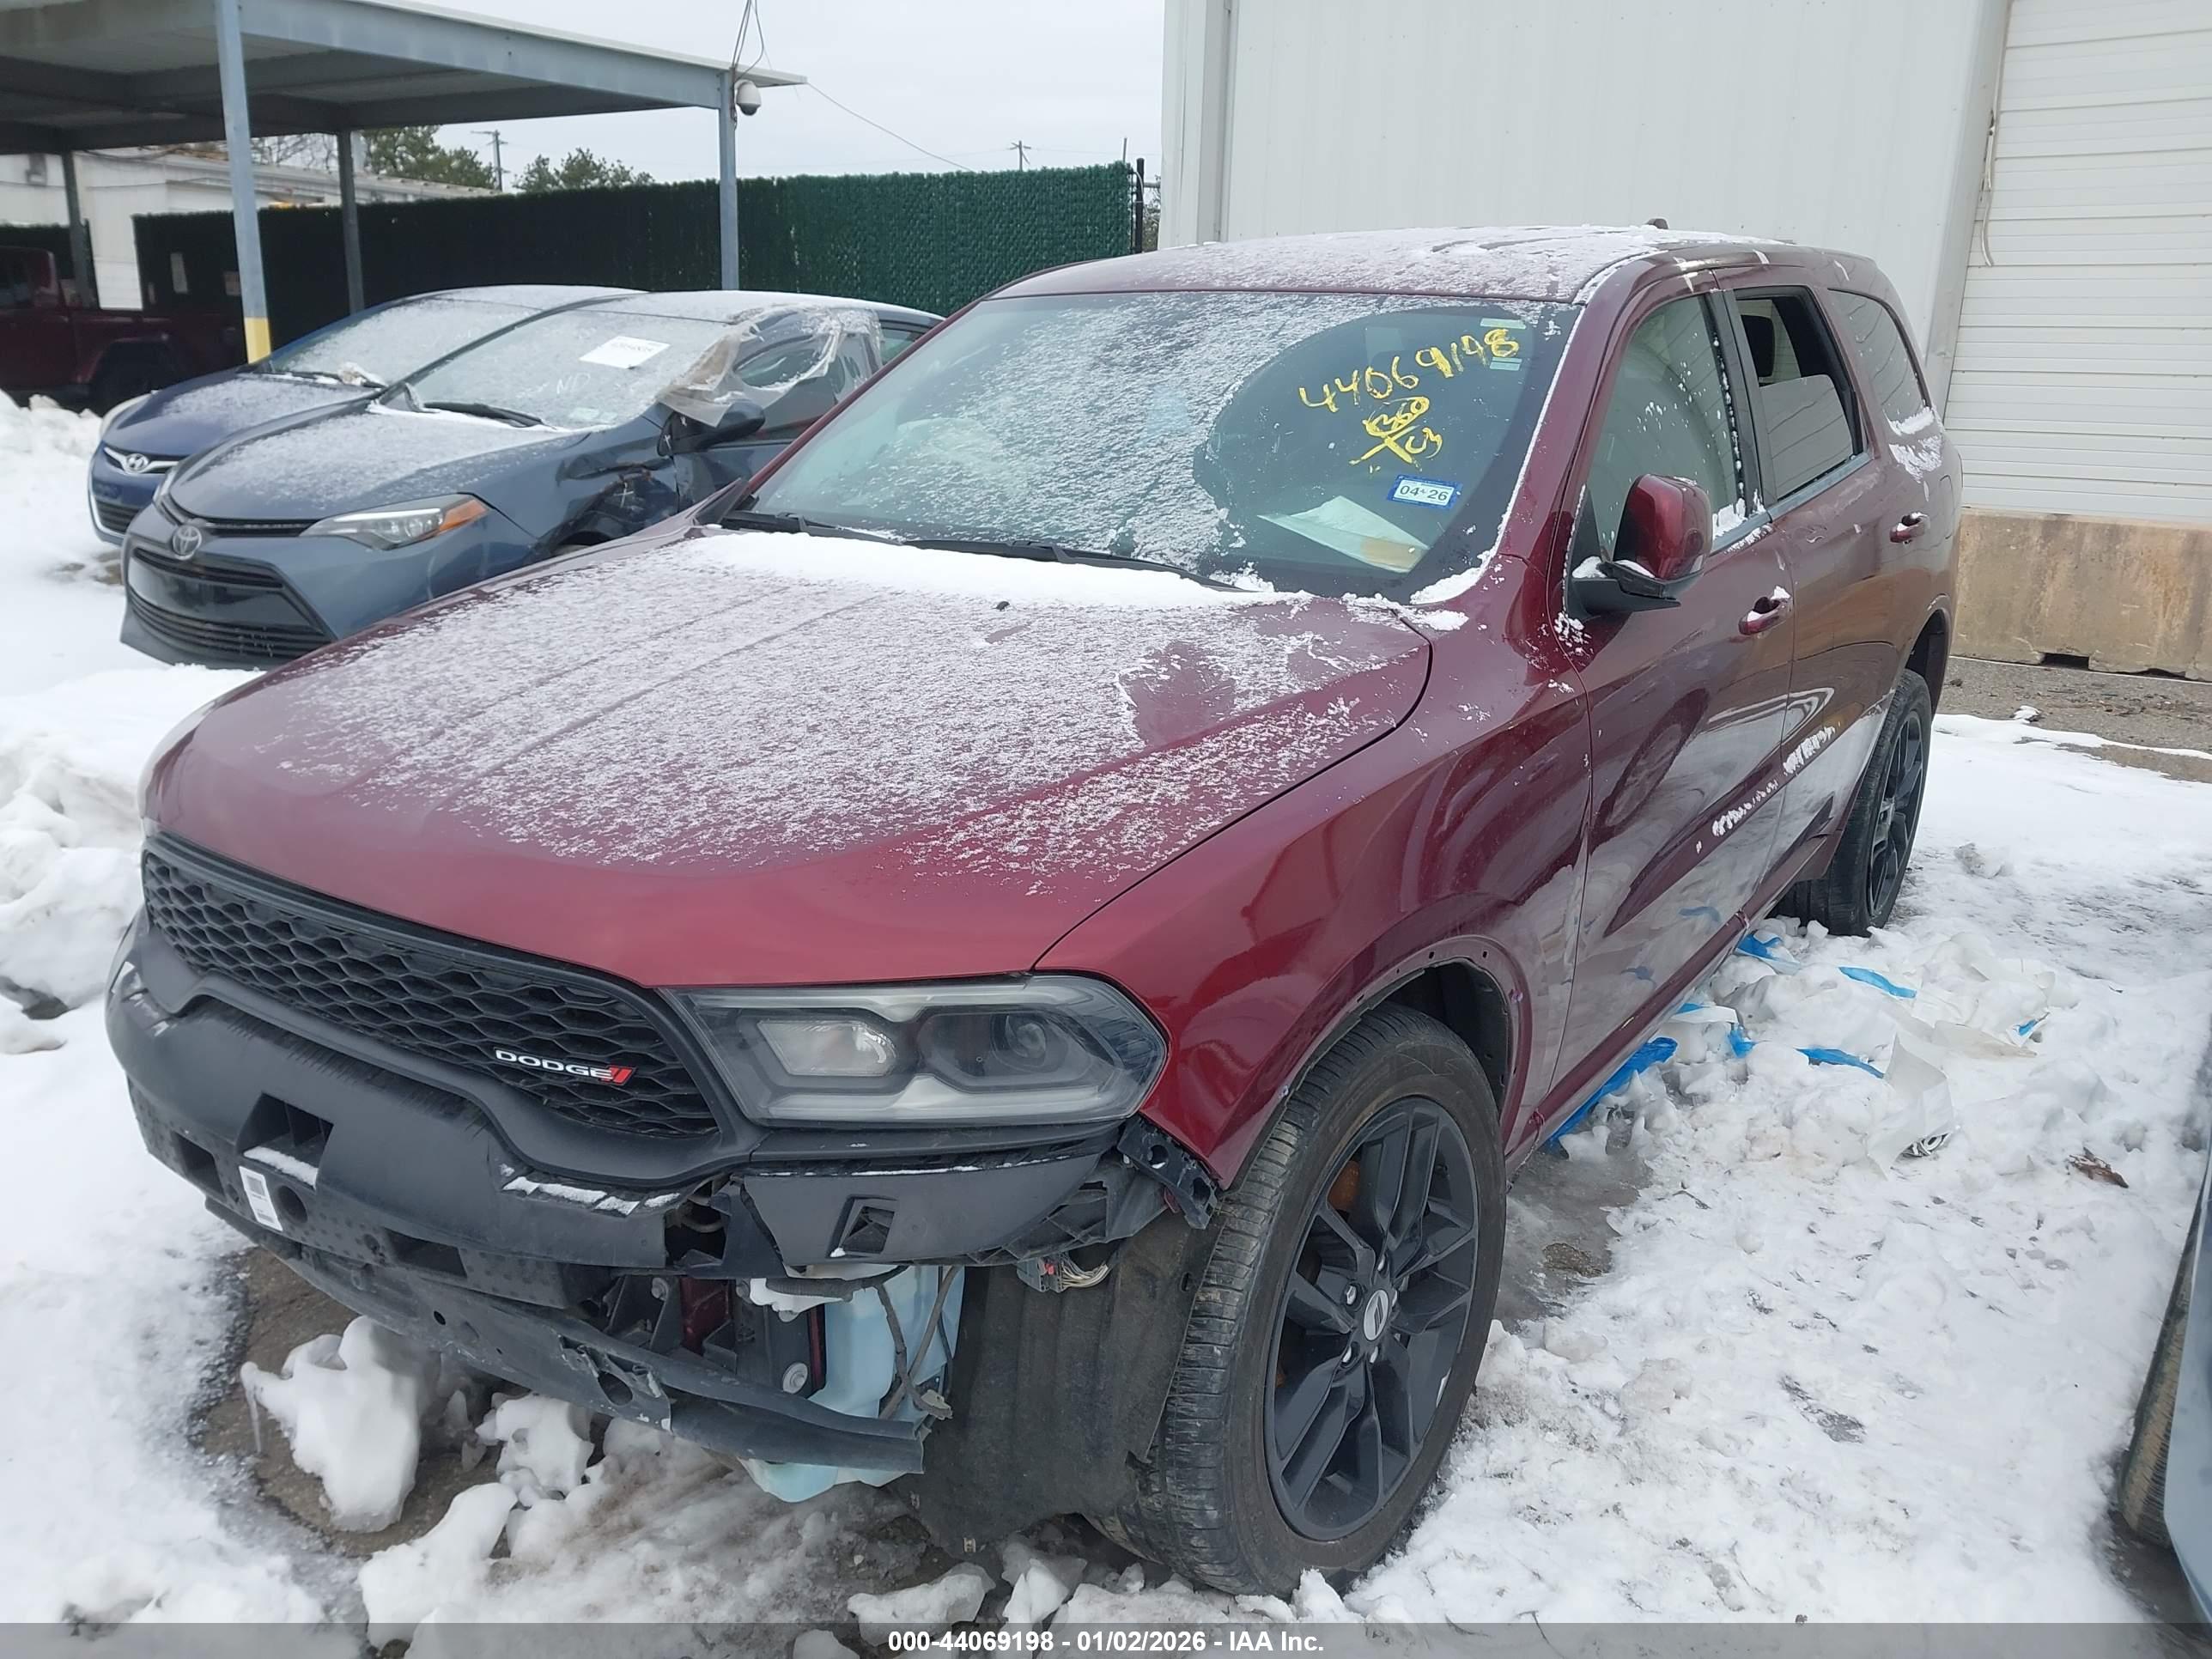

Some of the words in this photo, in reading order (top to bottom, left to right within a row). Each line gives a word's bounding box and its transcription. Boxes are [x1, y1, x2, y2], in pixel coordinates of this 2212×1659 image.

[1299, 328, 1519, 413] 44069198
[1400, 485, 1419, 496] 04
[1426, 489, 1449, 501] 26
[495, 1049, 613, 1080] DODGE
